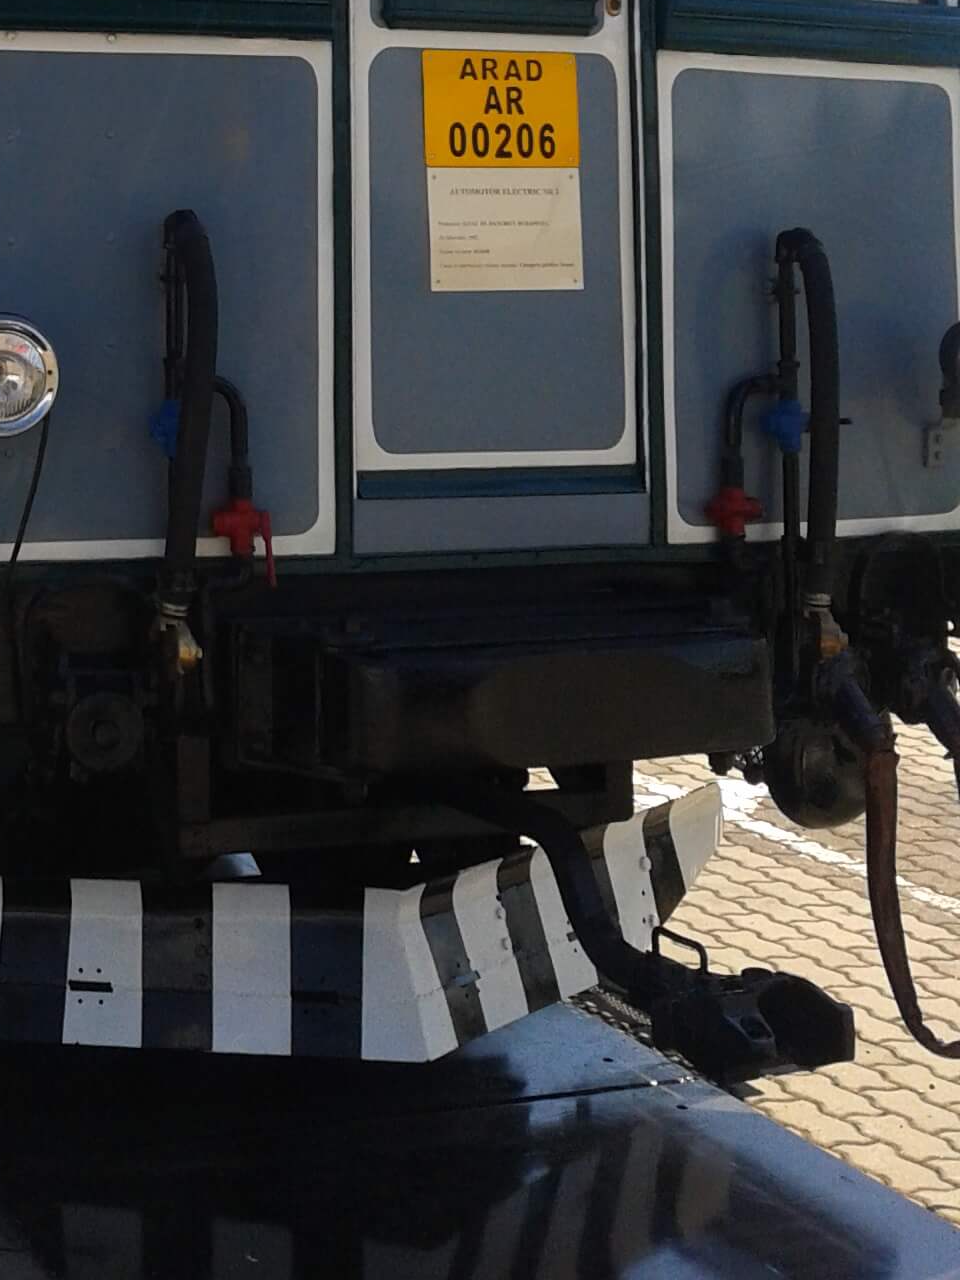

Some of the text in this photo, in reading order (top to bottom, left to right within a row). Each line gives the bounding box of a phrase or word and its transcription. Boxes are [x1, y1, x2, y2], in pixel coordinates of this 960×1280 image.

[459, 58, 543, 82] ARAD
[484, 86, 525, 115] AR
[449, 122, 556, 159] 00206
